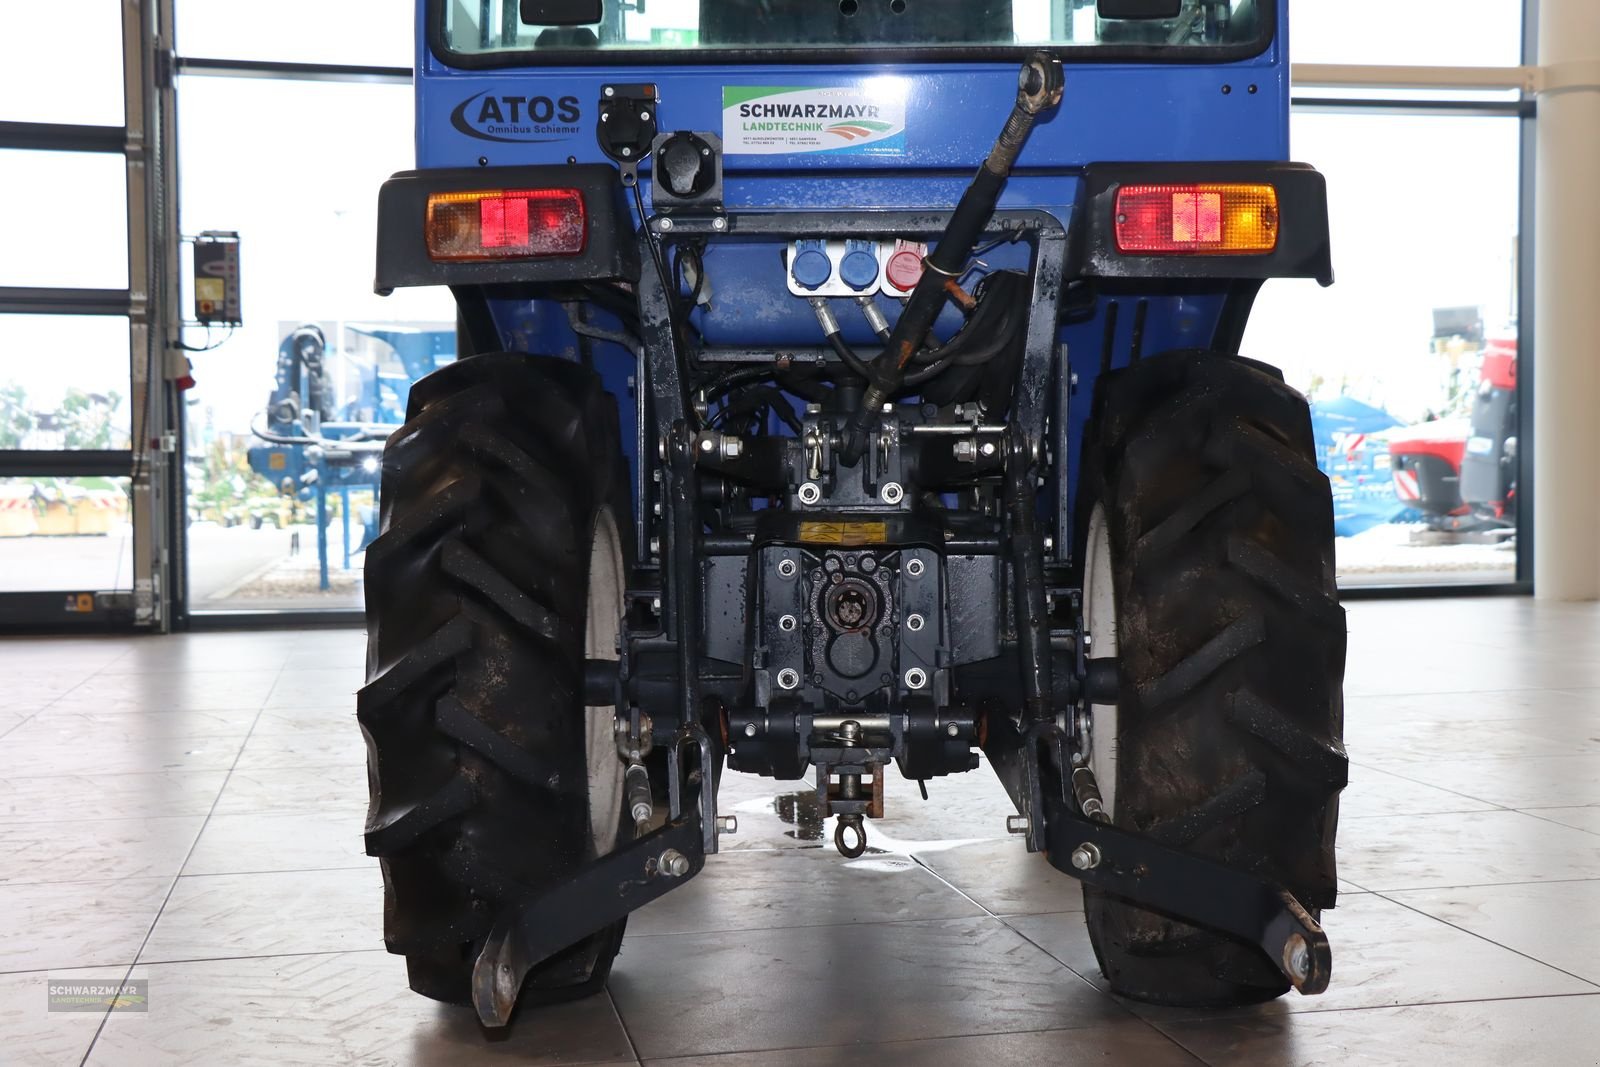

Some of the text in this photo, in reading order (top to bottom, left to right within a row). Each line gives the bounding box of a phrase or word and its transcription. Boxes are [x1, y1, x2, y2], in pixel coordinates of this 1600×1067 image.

[477, 96, 580, 123] ATOS
[739, 104, 879, 118] SCHWARZMAYR
[487, 124, 580, 134] Omnibus Schiemer
[743, 122, 823, 132] LANDTECHNIK
